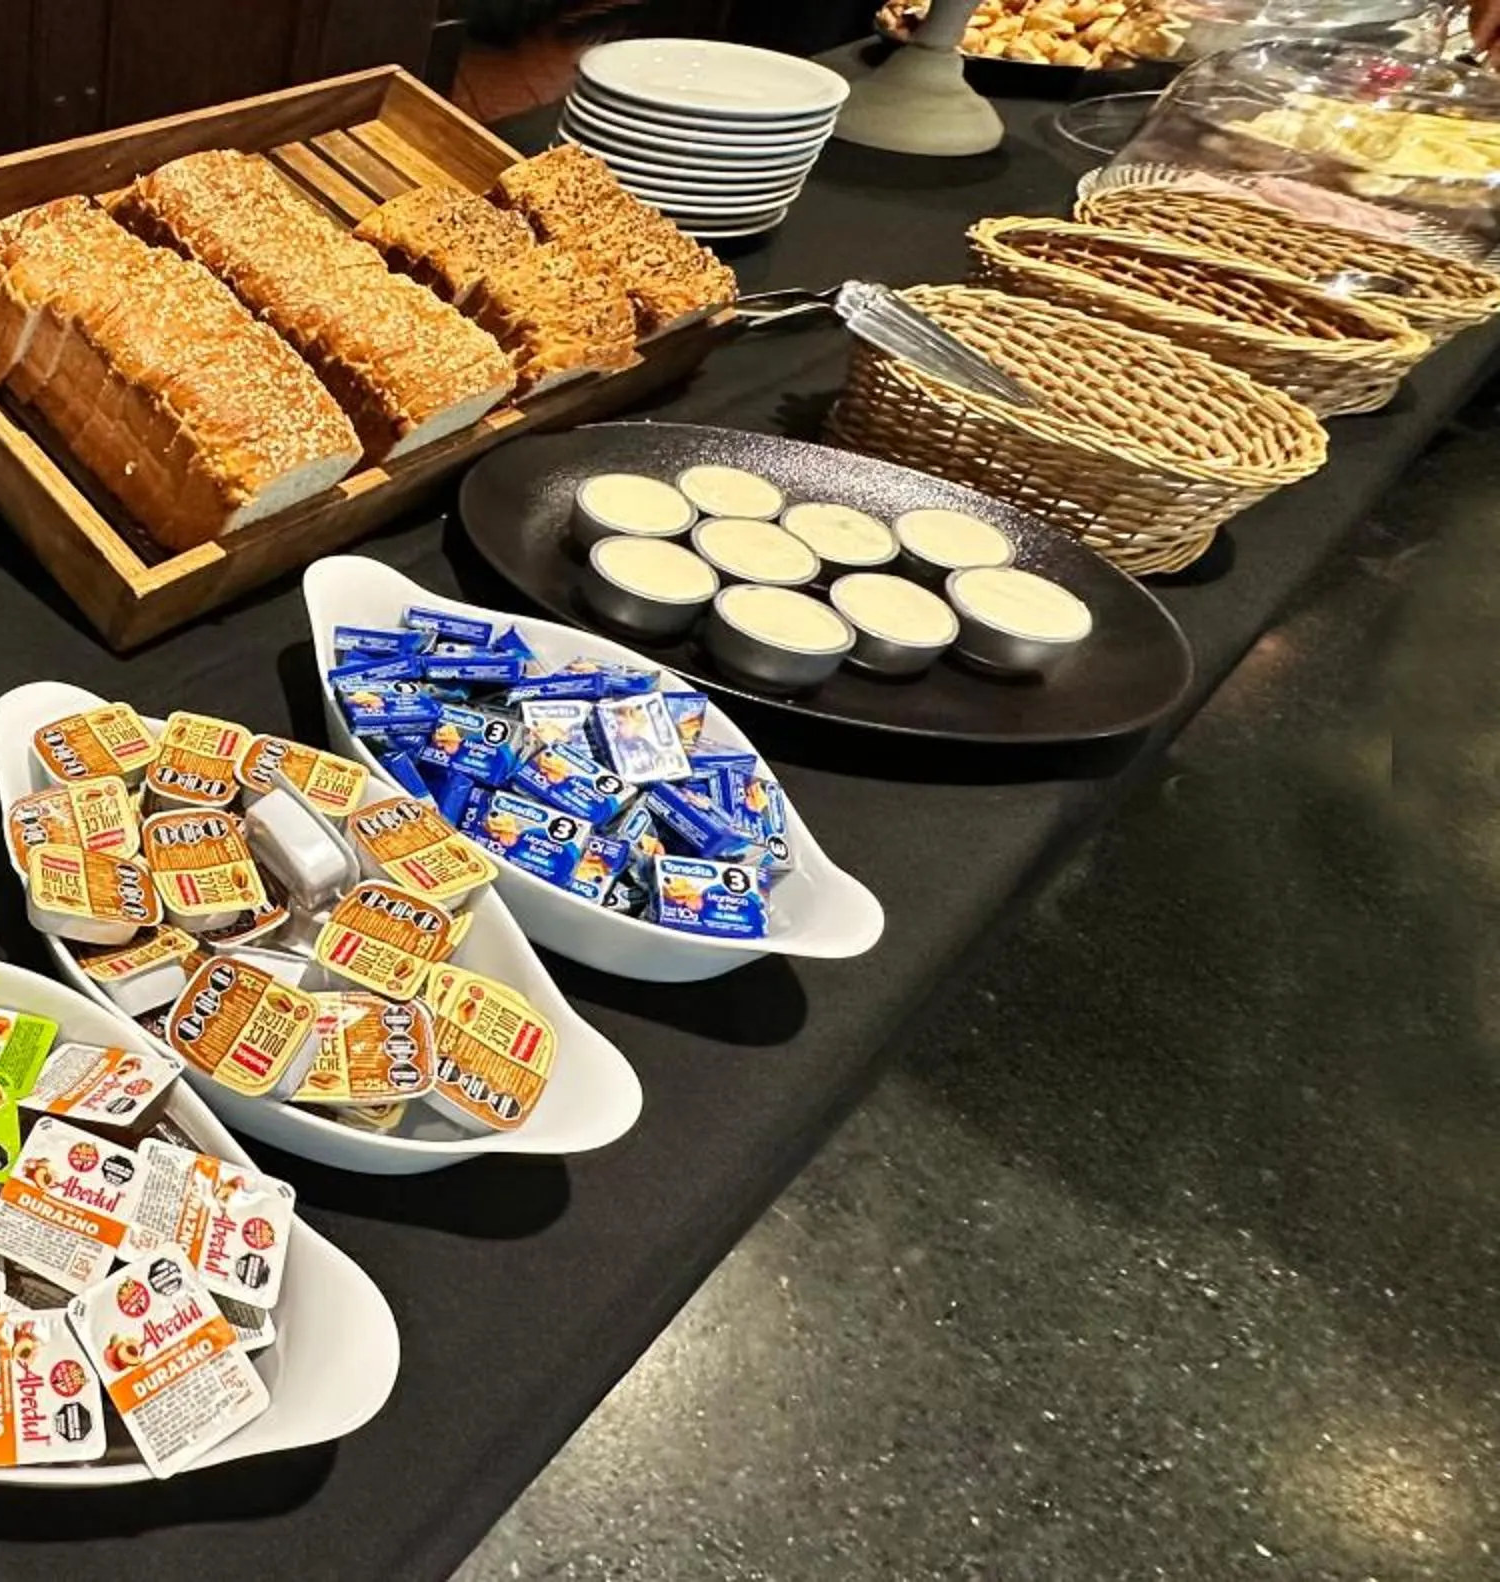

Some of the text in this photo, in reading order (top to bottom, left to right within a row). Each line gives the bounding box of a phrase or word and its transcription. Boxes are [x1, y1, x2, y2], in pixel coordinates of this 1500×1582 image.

[489, 724, 503, 741] 3
[602, 777, 617, 793] 3
[556, 820, 572, 839] 3
[730, 873, 746, 891] 3
[349, 939, 382, 976] DULCE
[254, 1005, 287, 1033] LECHE
[486, 1007, 521, 1050] DULCE
[243, 1021, 287, 1058] DULCE
[51, 1176, 122, 1213] Abedul
[18, 1194, 100, 1234] DURAZNO
[204, 1201, 238, 1278] Abedul
[139, 1297, 203, 1355] Abedul
[131, 1339, 214, 1399] DURAZNO
[16, 1359, 50, 1442] Abedul
